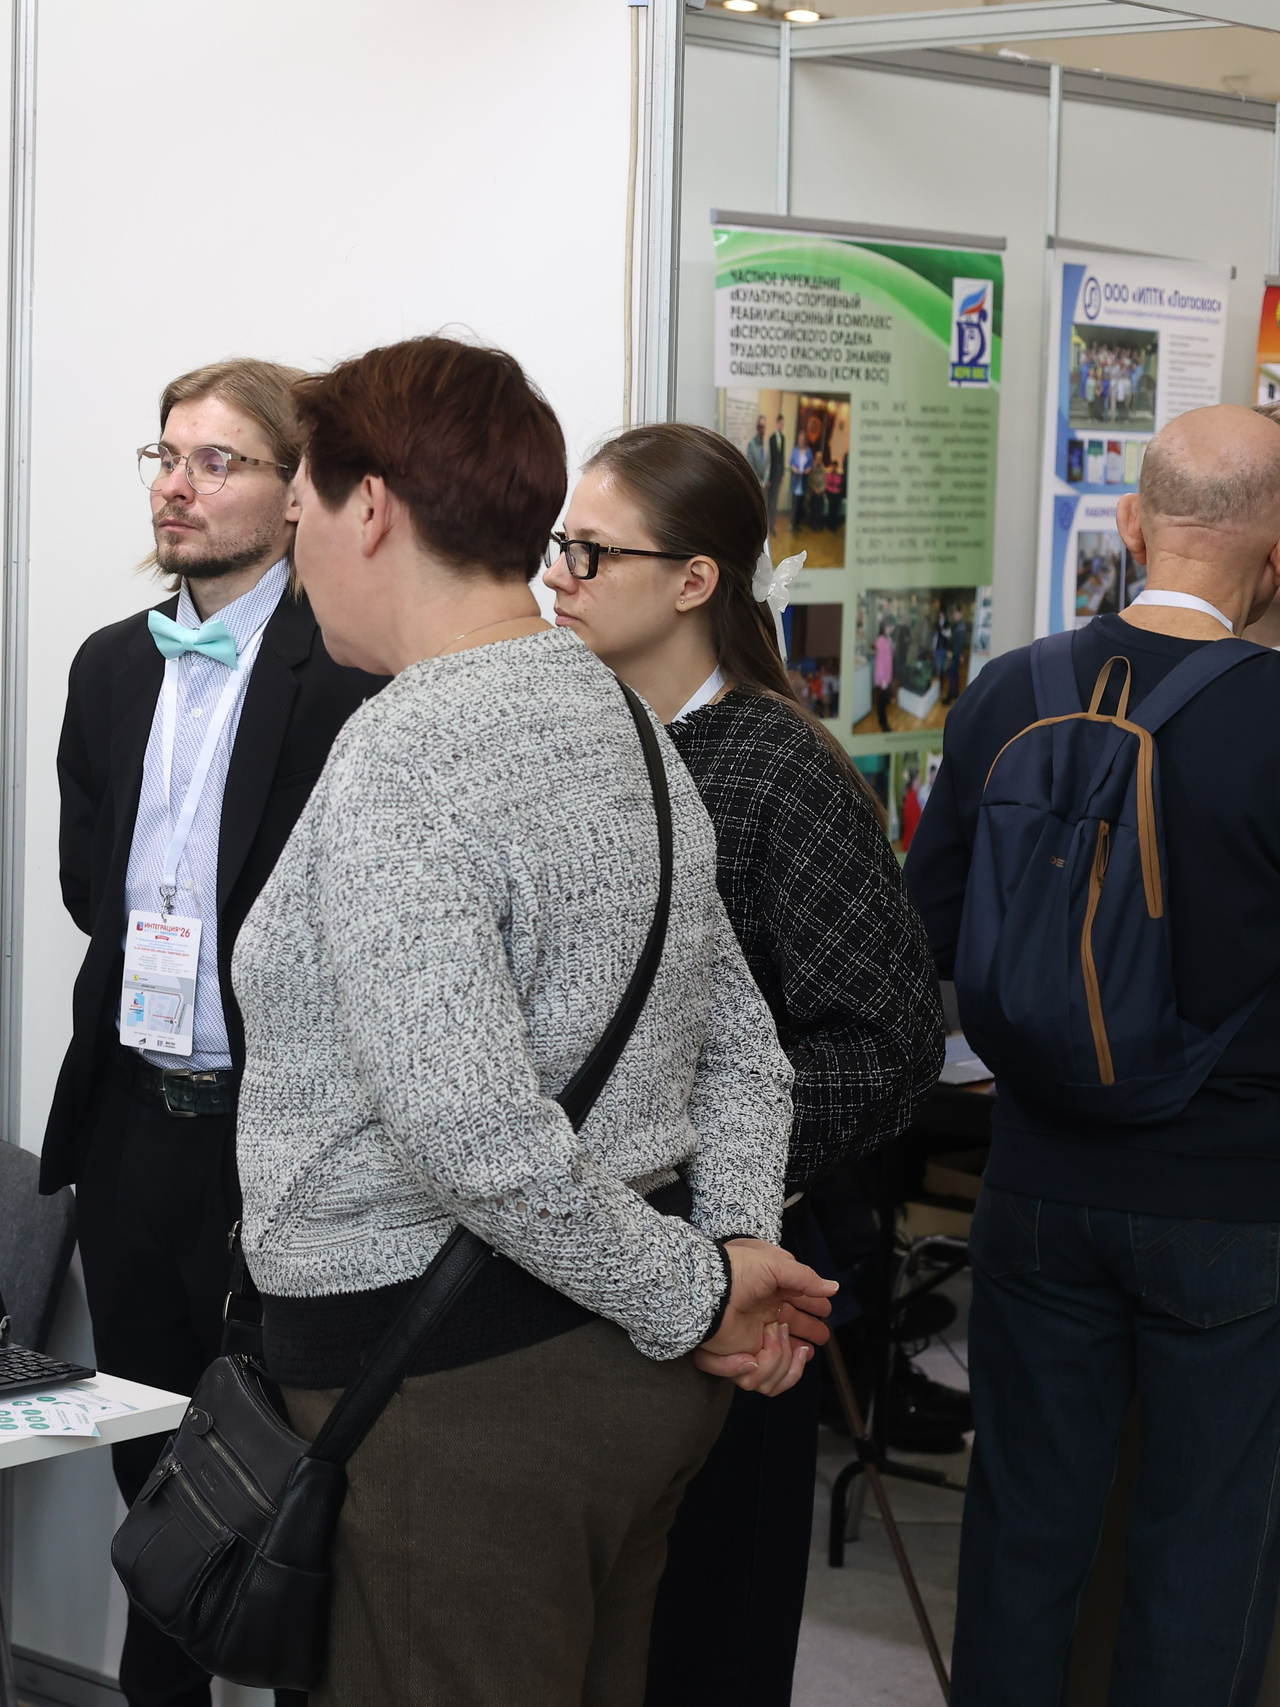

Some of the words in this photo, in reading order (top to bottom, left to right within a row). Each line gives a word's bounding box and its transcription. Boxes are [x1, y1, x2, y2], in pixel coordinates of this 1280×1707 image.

[730, 269, 777, 287] ЧАСТНОЕ
[781, 273, 841, 291] УЧРЕЖДЕНИЕ
[1104, 283, 1129, 303] ООО
[731, 306, 834, 327] РЕАБИЛИТАЦИОННЫЙ
[837, 313, 892, 330] КОМПЛЕКС
[830, 330, 873, 346] ОРДЕНА
[730, 342, 788, 359] ТРУДОВОГО
[791, 347, 842, 363] КРАСНОГО
[846, 350, 892, 365] ЗНАМЕНИ
[730, 361, 782, 377] ОБЩЕСТВА
[144, 922, 179, 933] ИНТЕГРАЦИЯ
